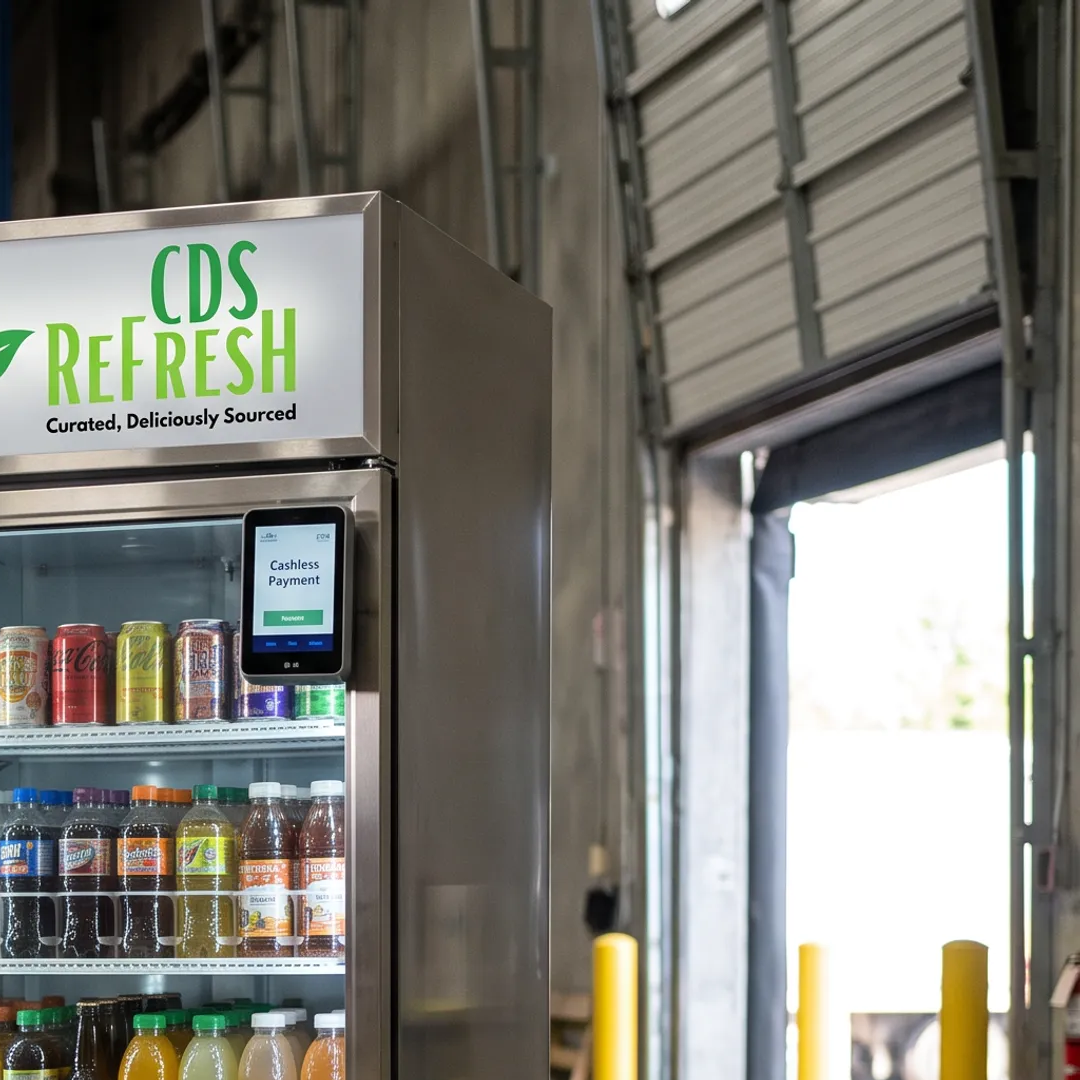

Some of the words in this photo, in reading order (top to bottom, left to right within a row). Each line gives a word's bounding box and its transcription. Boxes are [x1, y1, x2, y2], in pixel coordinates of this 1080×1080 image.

[151, 241, 258, 325] CDS
[46, 413, 122, 434] Curated,
[127, 406, 220, 430] Deliciously
[223, 402, 297, 424] Sourced
[270, 559, 320, 571] Cashless
[268, 574, 321, 589] Payment
